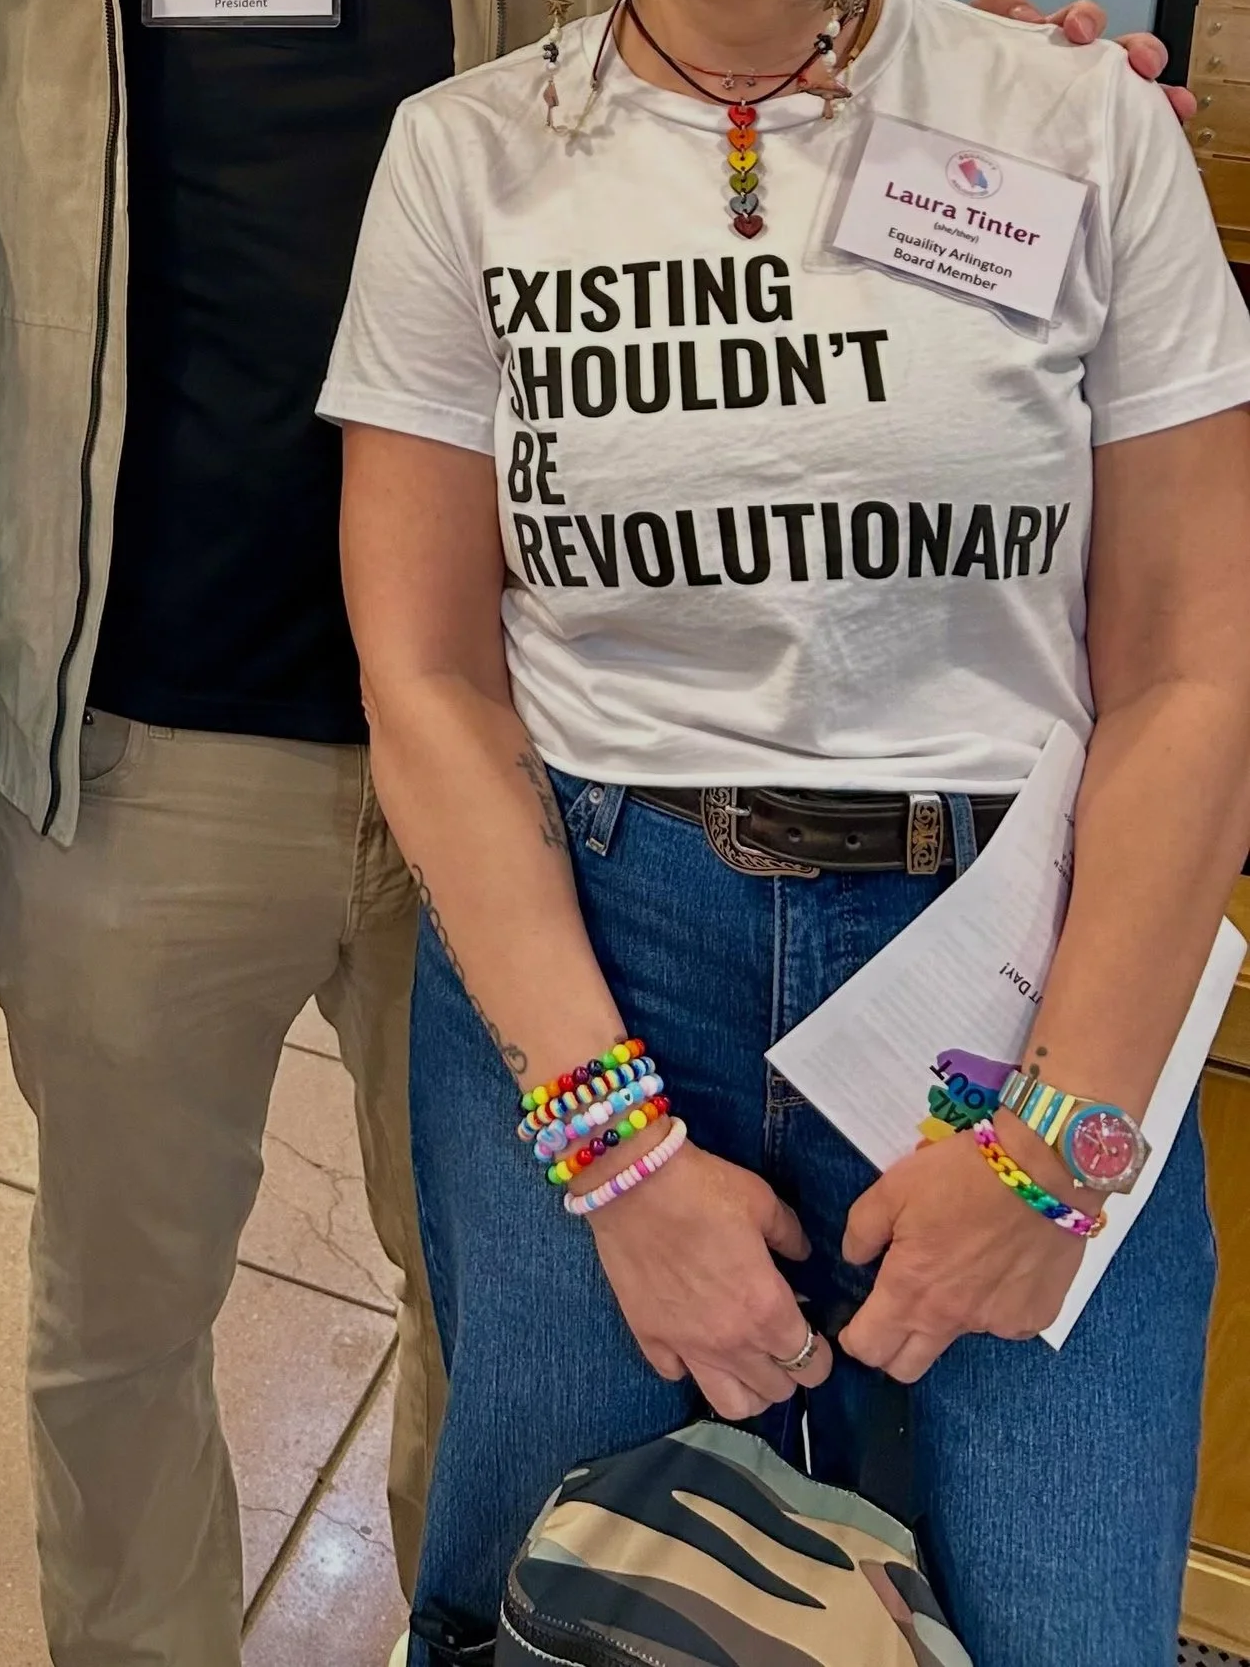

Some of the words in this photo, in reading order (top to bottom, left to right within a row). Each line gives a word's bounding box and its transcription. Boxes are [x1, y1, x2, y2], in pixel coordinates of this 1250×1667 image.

[885, 182, 957, 219] Laura
[966, 207, 1040, 246] Tinter
[483, 254, 792, 339] EXISTING
[893, 248, 936, 270] Board
[937, 262, 997, 291] Member
[949, 248, 1013, 278] Arlington
[508, 329, 889, 421] SHOULDN'T
[508, 431, 565, 505] BE
[513, 501, 1070, 589] REVOLUTIONARY
[929, 1060, 985, 1109] OUT
